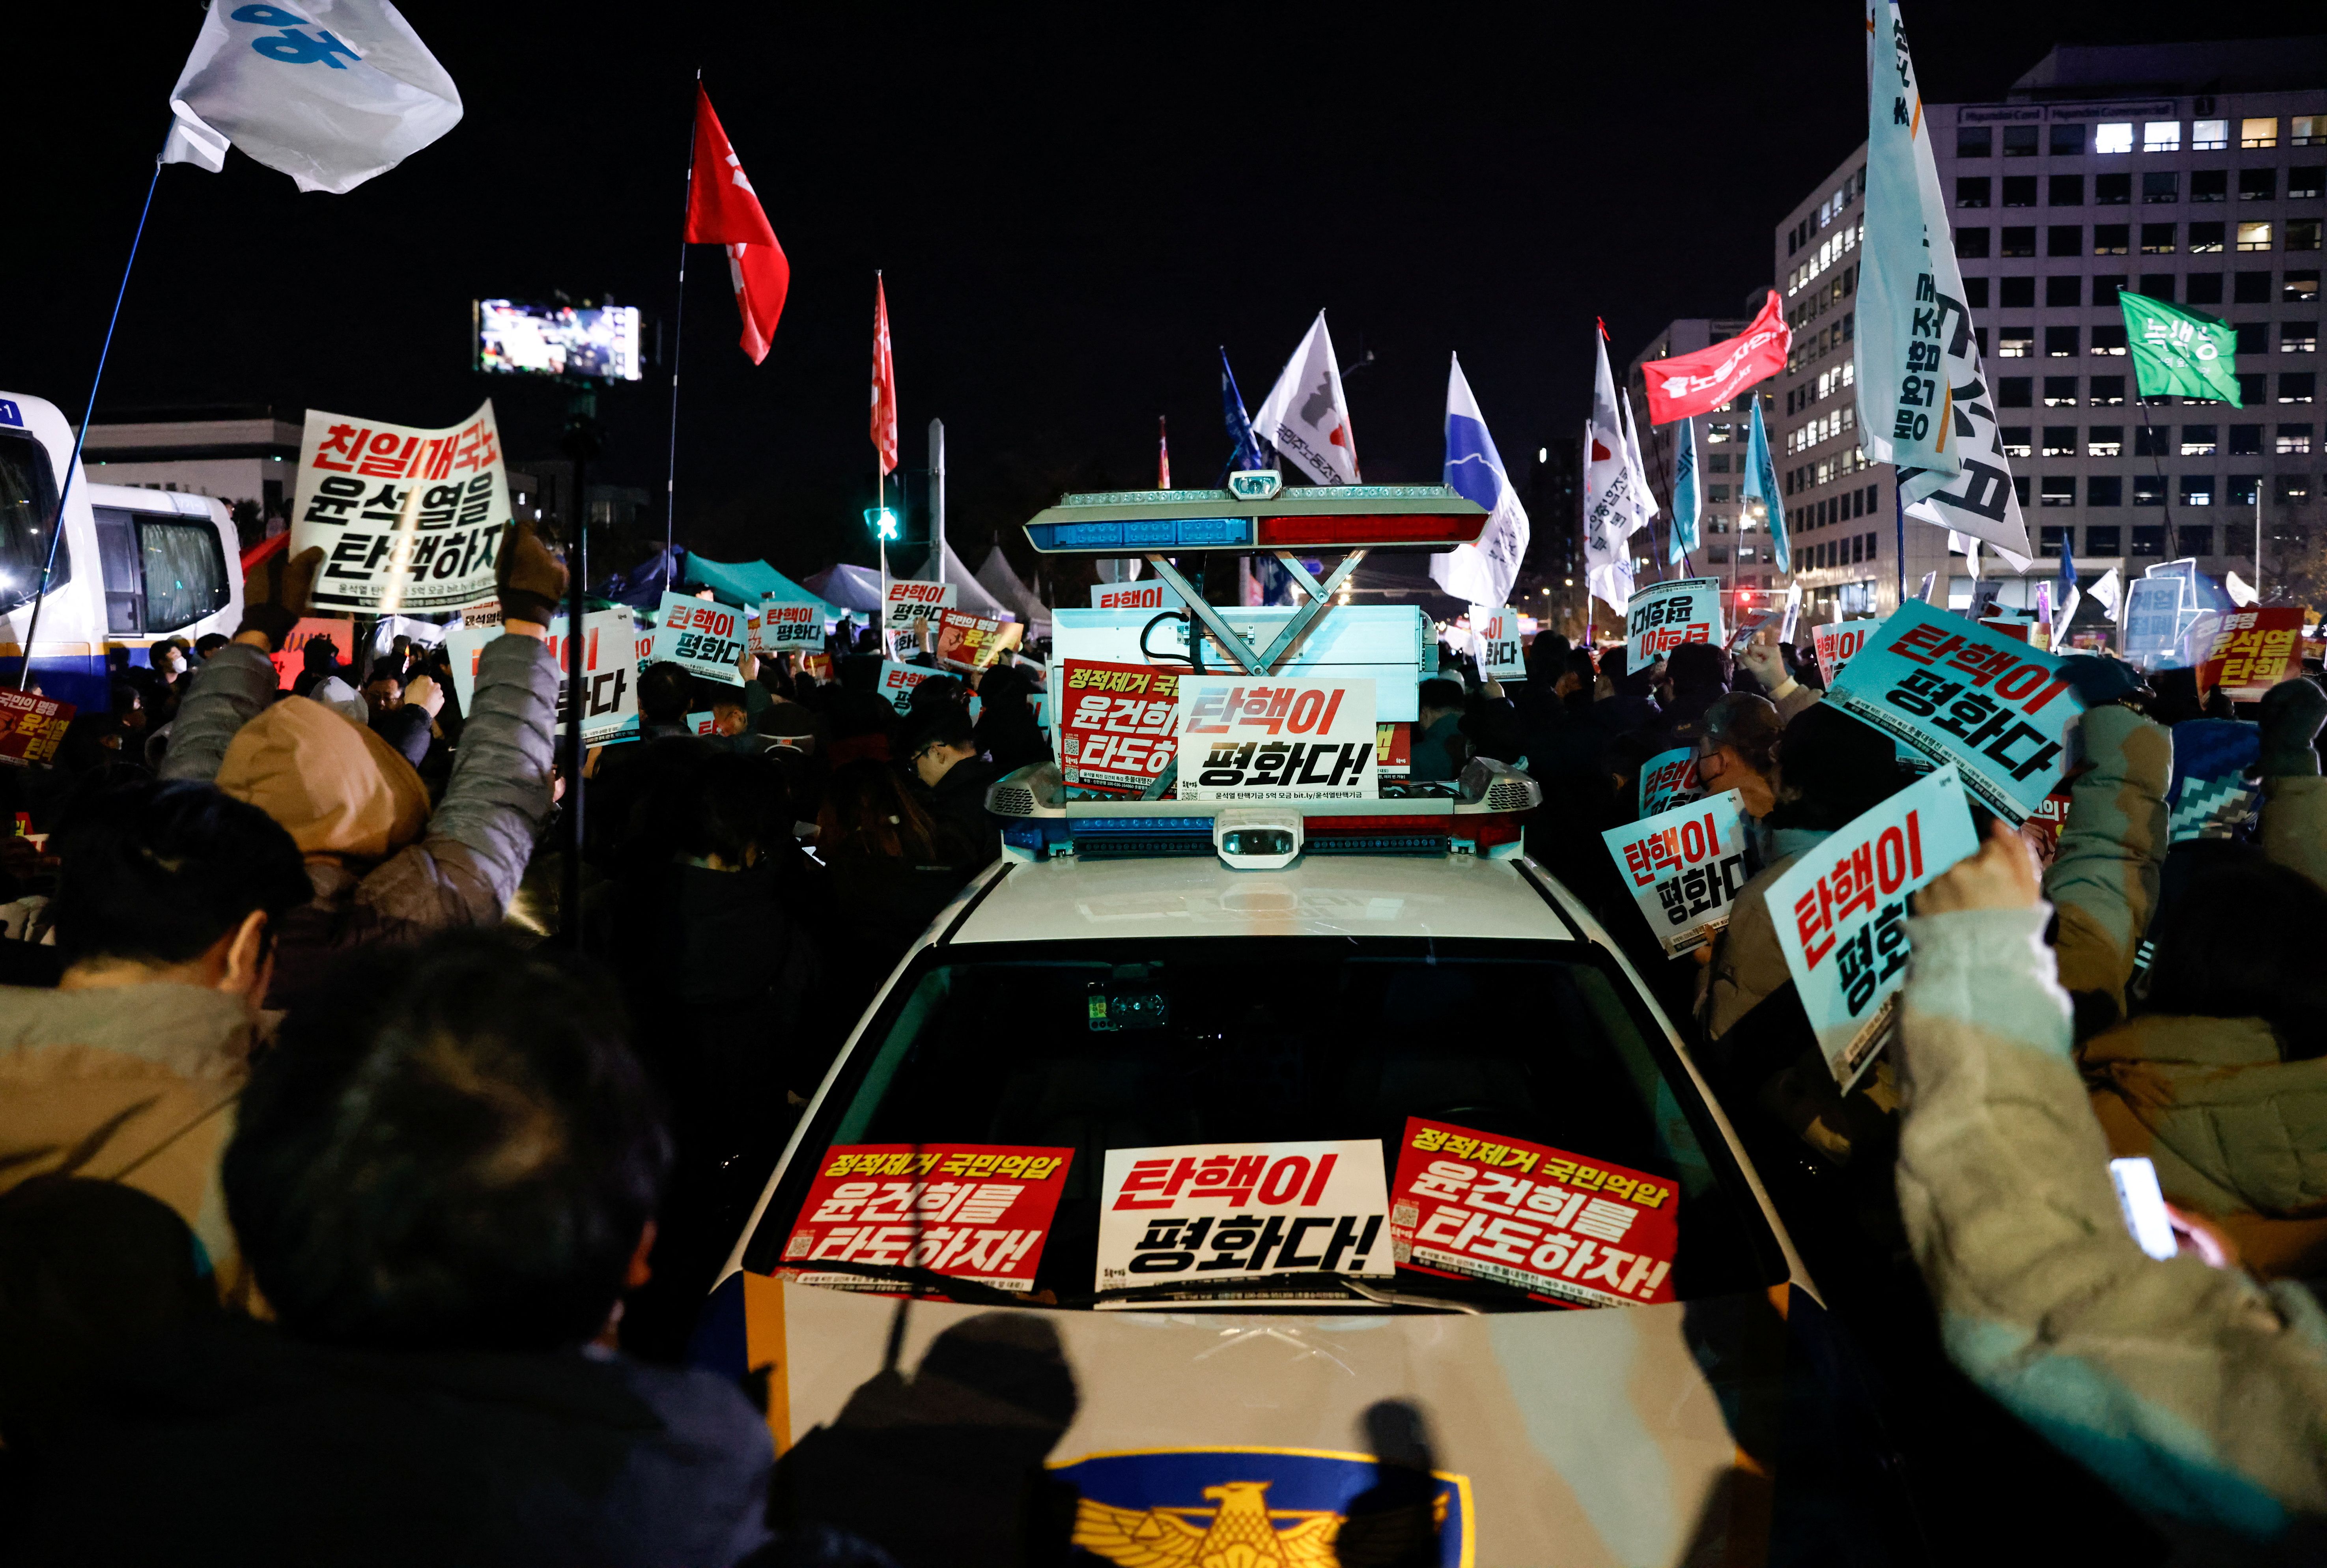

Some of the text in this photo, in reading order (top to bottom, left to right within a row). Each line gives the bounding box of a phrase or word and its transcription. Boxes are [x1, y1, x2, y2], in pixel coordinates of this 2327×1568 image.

[312, 418, 497, 480] 친일매국노
[304, 472, 493, 530] 윤석열을
[888, 584, 945, 603] 탄핵이
[1101, 587, 1162, 608] 탄핵이
[666, 605, 734, 638] 탄핵이
[767, 607, 813, 625] 탄핵이
[777, 624, 821, 640] 평화다
[945, 613, 976, 629] 국민의
[675, 632, 744, 667] 평화다
[1485, 641, 1517, 666] 화다
[1817, 629, 1864, 666] 탄핵이
[2209, 629, 2297, 661] 윤석열
[1068, 668, 1151, 694] 정적제거
[1888, 623, 2070, 715] 탄핵이
[2219, 657, 2288, 685] 탄핵
[15, 713, 69, 741] 윤석열
[1071, 696, 1178, 736] 윤건희
[1186, 687, 1345, 735] 탄핵이
[1885, 668, 2063, 782] 평화다
[22, 737, 59, 762] 탄핵
[1079, 734, 1177, 773] 타도하
[1199, 741, 1373, 786] 평화다!
[1124, 776, 1152, 784] 촛불대행진
[1623, 812, 1720, 887] 탄핵이
[1794, 810, 1924, 971] 탄핵이
[1835, 889, 1918, 1018] 평화
[825, 1153, 1063, 1180] 정적제거 국민억압
[1112, 1154, 1339, 1211] 탄핵이
[1412, 1127, 1670, 1208] 정적제거 국민억압
[810, 1182, 1025, 1224] 윤건희를
[1409, 1160, 1639, 1243] 윤건희를
[807, 1225, 1042, 1272] 타도하자!
[1128, 1215, 1384, 1274] 평화다!
[1416, 1205, 1671, 1299] 타도하자!
